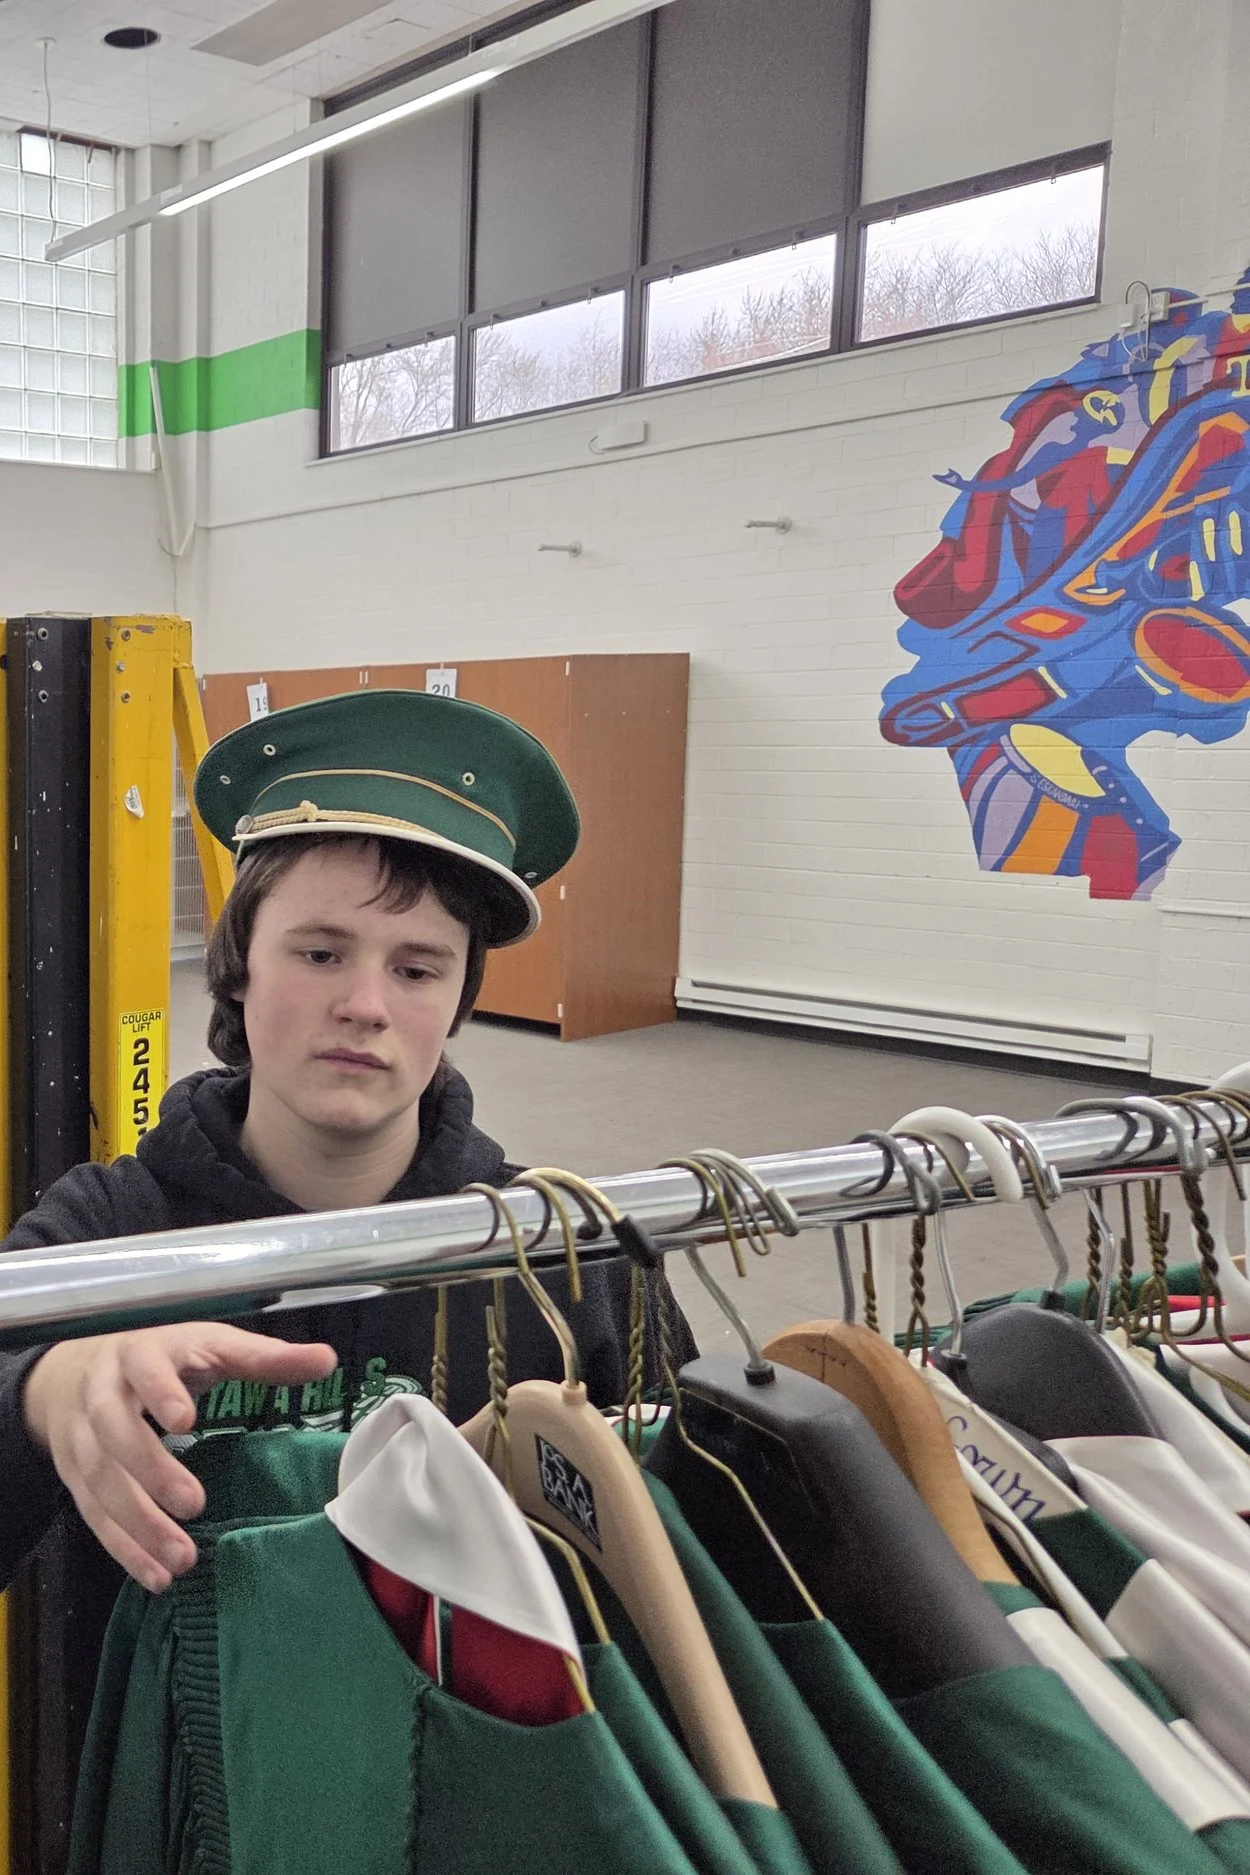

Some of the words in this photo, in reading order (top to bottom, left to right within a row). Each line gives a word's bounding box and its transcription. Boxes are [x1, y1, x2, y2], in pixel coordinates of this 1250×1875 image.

[432, 683, 450, 697] 20
[121, 1011, 162, 1025] COUGAR
[132, 1022, 151, 1033] LIFT
[132, 1036, 150, 1136] 245
[541, 1461, 597, 1536] BANK
